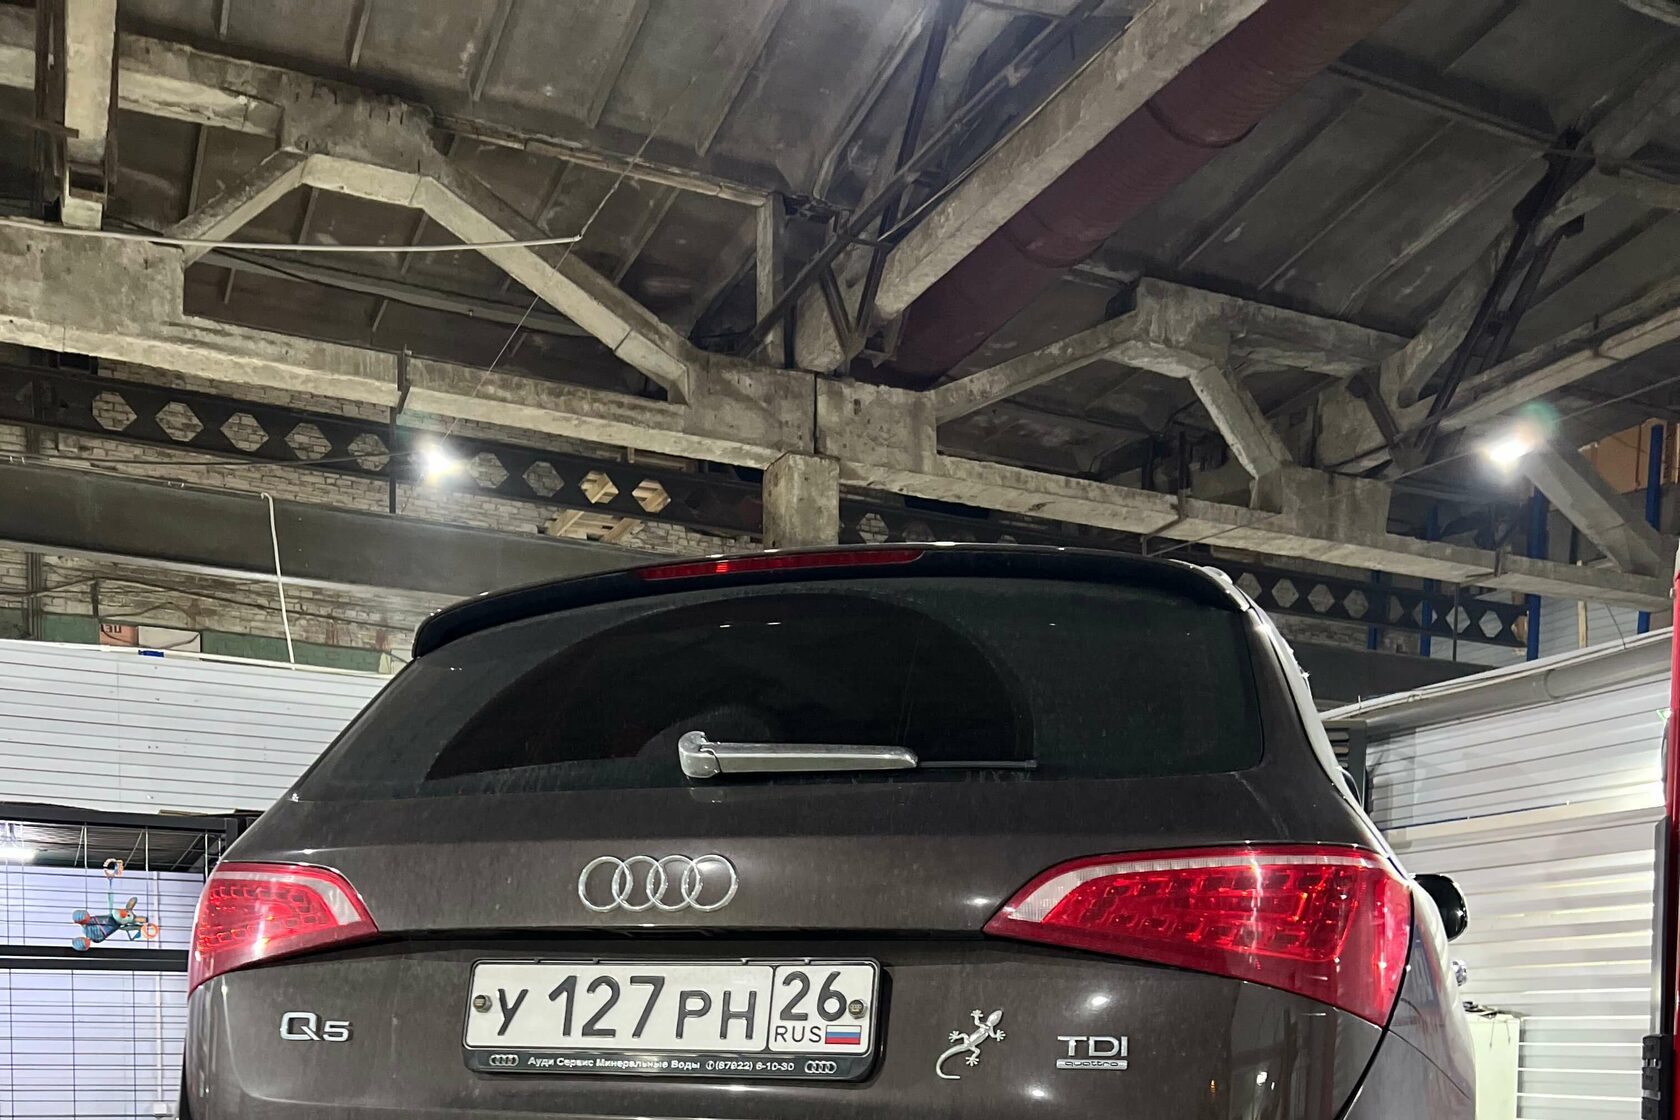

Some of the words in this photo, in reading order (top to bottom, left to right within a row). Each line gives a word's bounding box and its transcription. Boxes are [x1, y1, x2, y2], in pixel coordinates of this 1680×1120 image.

[548, 975, 665, 1038] 127
[780, 970, 847, 1022] 26
[280, 1011, 350, 1042] Q5
[774, 1025, 822, 1043] RUS
[1057, 1035, 1128, 1057] TDI
[528, 1056, 553, 1070] Ауди
[556, 1057, 594, 1069] Сервис
[596, 1057, 669, 1069] Минеральные
[671, 1060, 700, 1070] Воды
